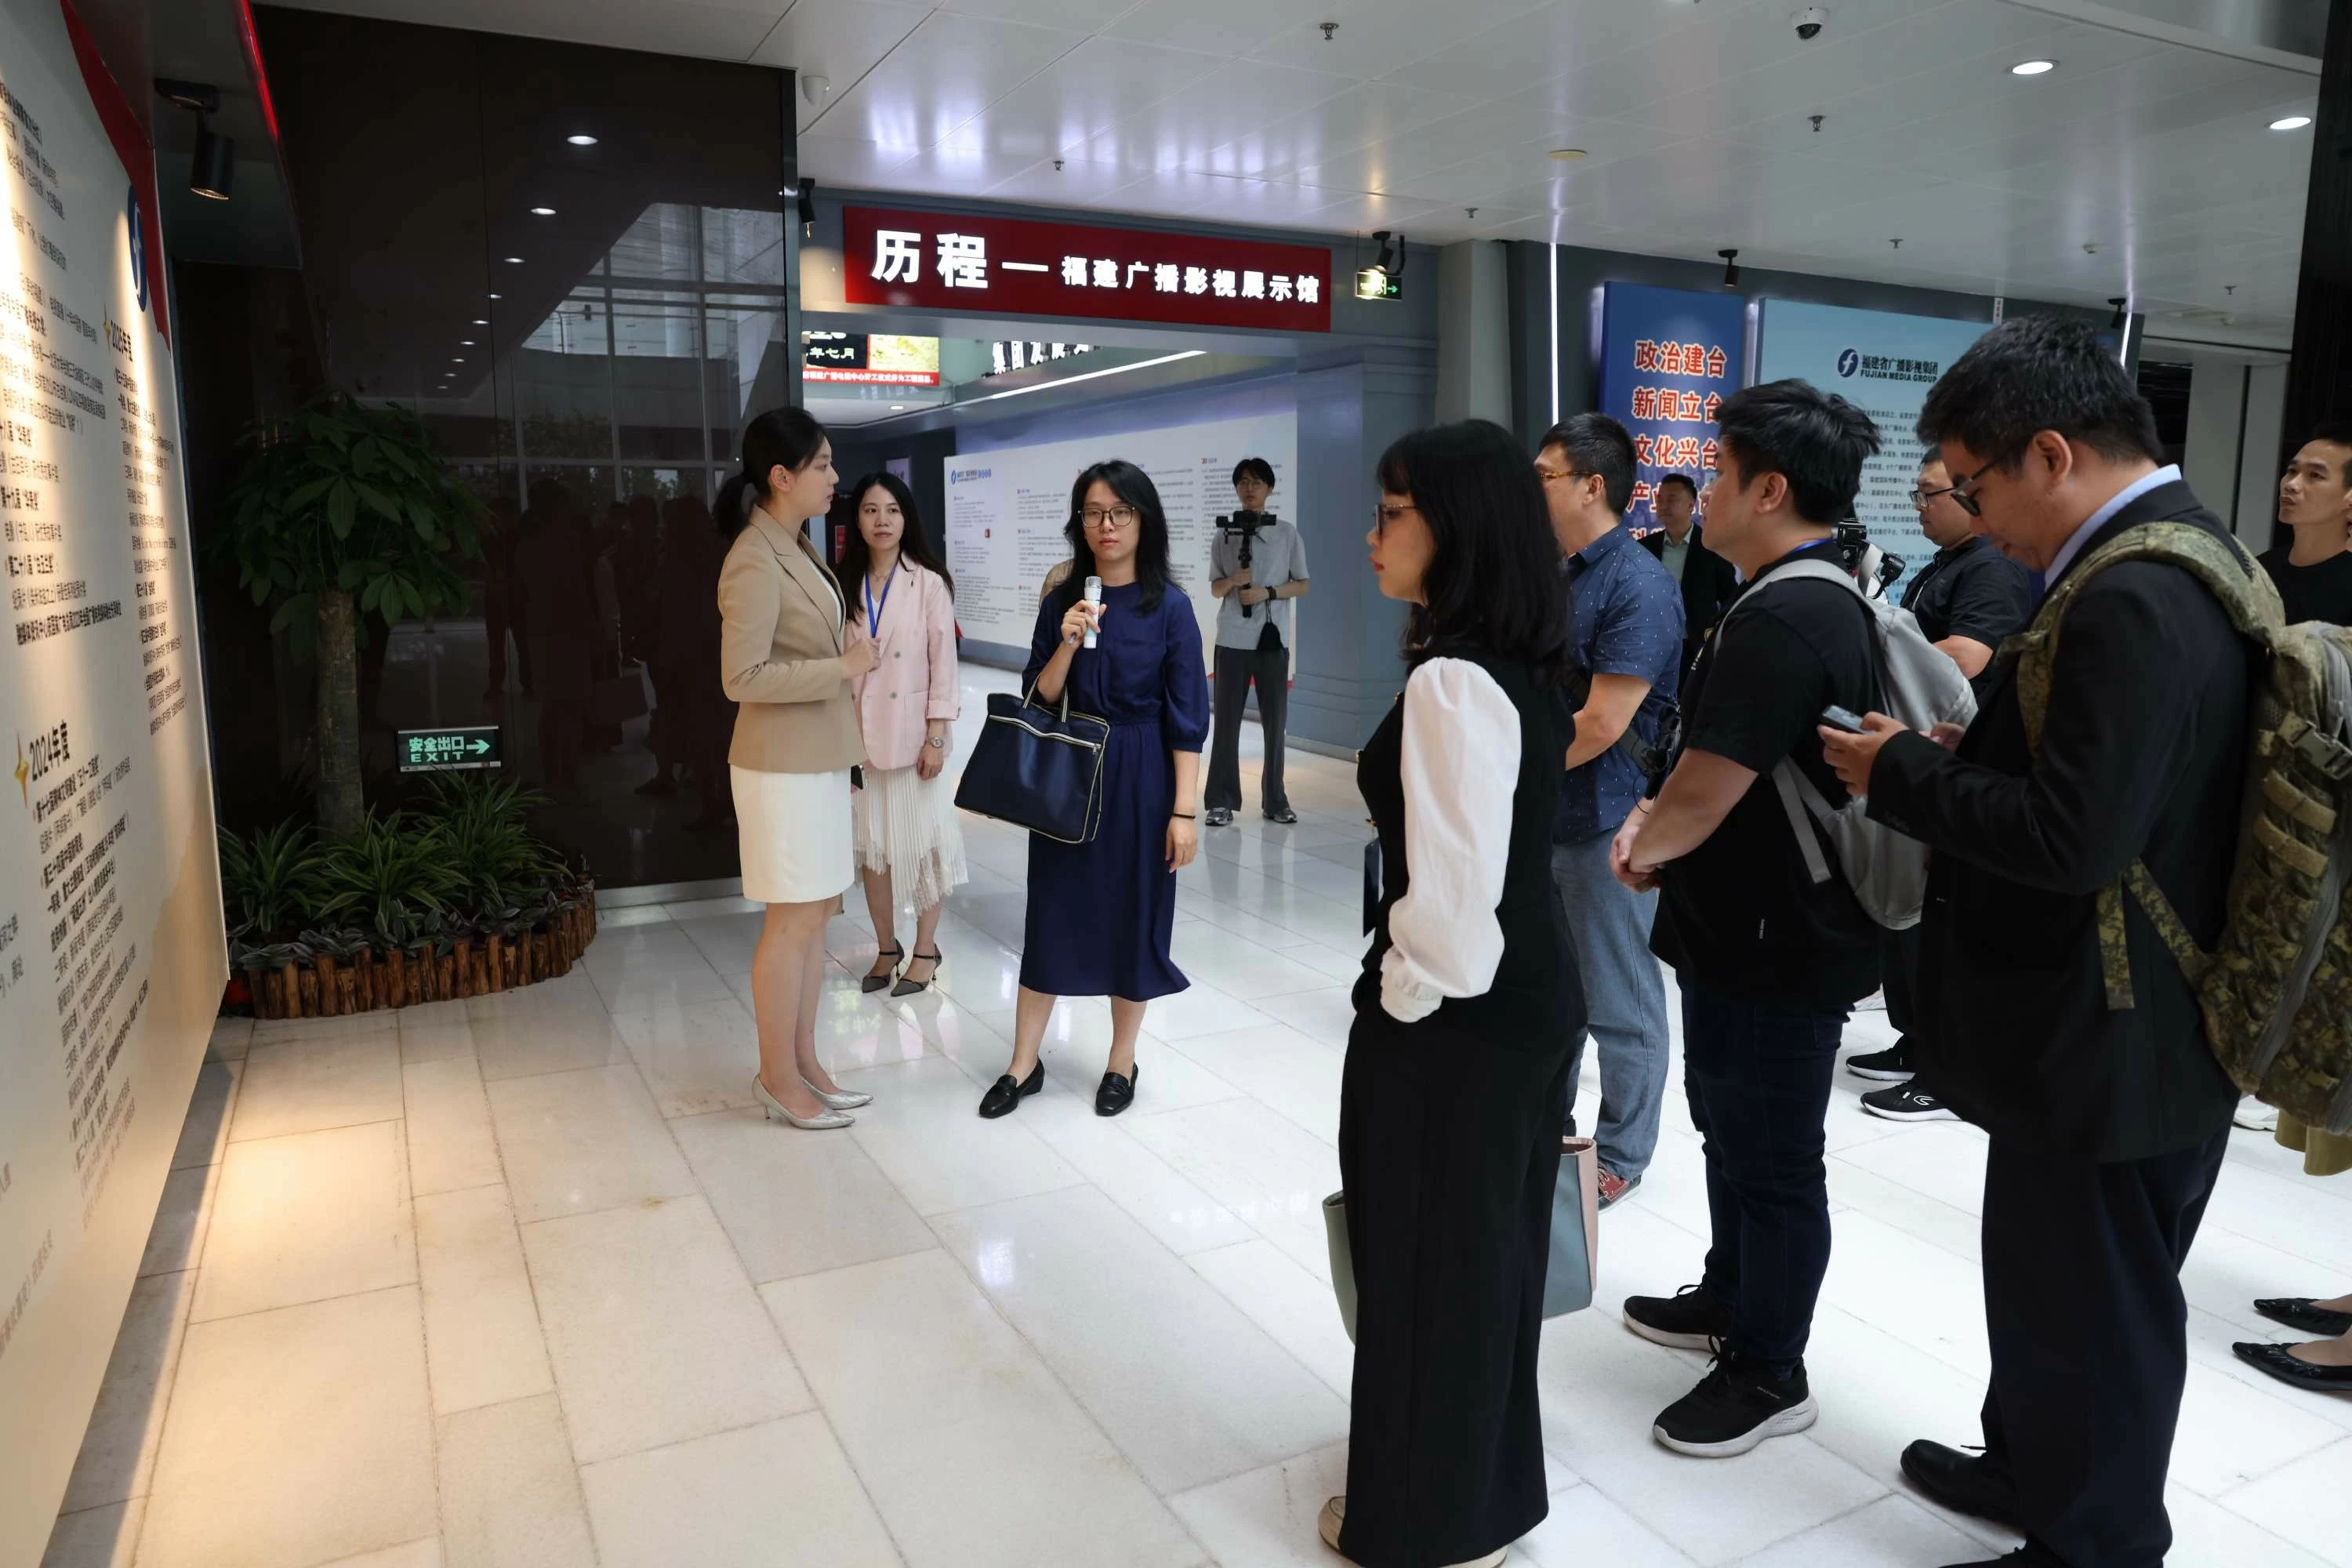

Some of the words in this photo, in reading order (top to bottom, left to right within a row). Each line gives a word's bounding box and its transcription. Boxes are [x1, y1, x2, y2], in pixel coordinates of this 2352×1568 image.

[871, 230, 989, 289] 历程
[1061, 256, 1320, 303] 福建广播影视展示馆
[806, 346, 855, 360] 年七月
[1635, 339, 1727, 379] 政治建台
[1862, 354, 1939, 376] 福建省广播影视集团
[1860, 369, 1888, 379] FUJIAN
[1889, 372, 1911, 381] MEDIA
[1912, 373, 1937, 383] GROUP
[1632, 386, 1724, 423] 新闻立台
[1635, 433, 1719, 470] 文化兴台
[28, 719, 71, 782] 2024年度
[408, 736, 465, 752] 安全出口
[411, 751, 464, 763] EXIT
